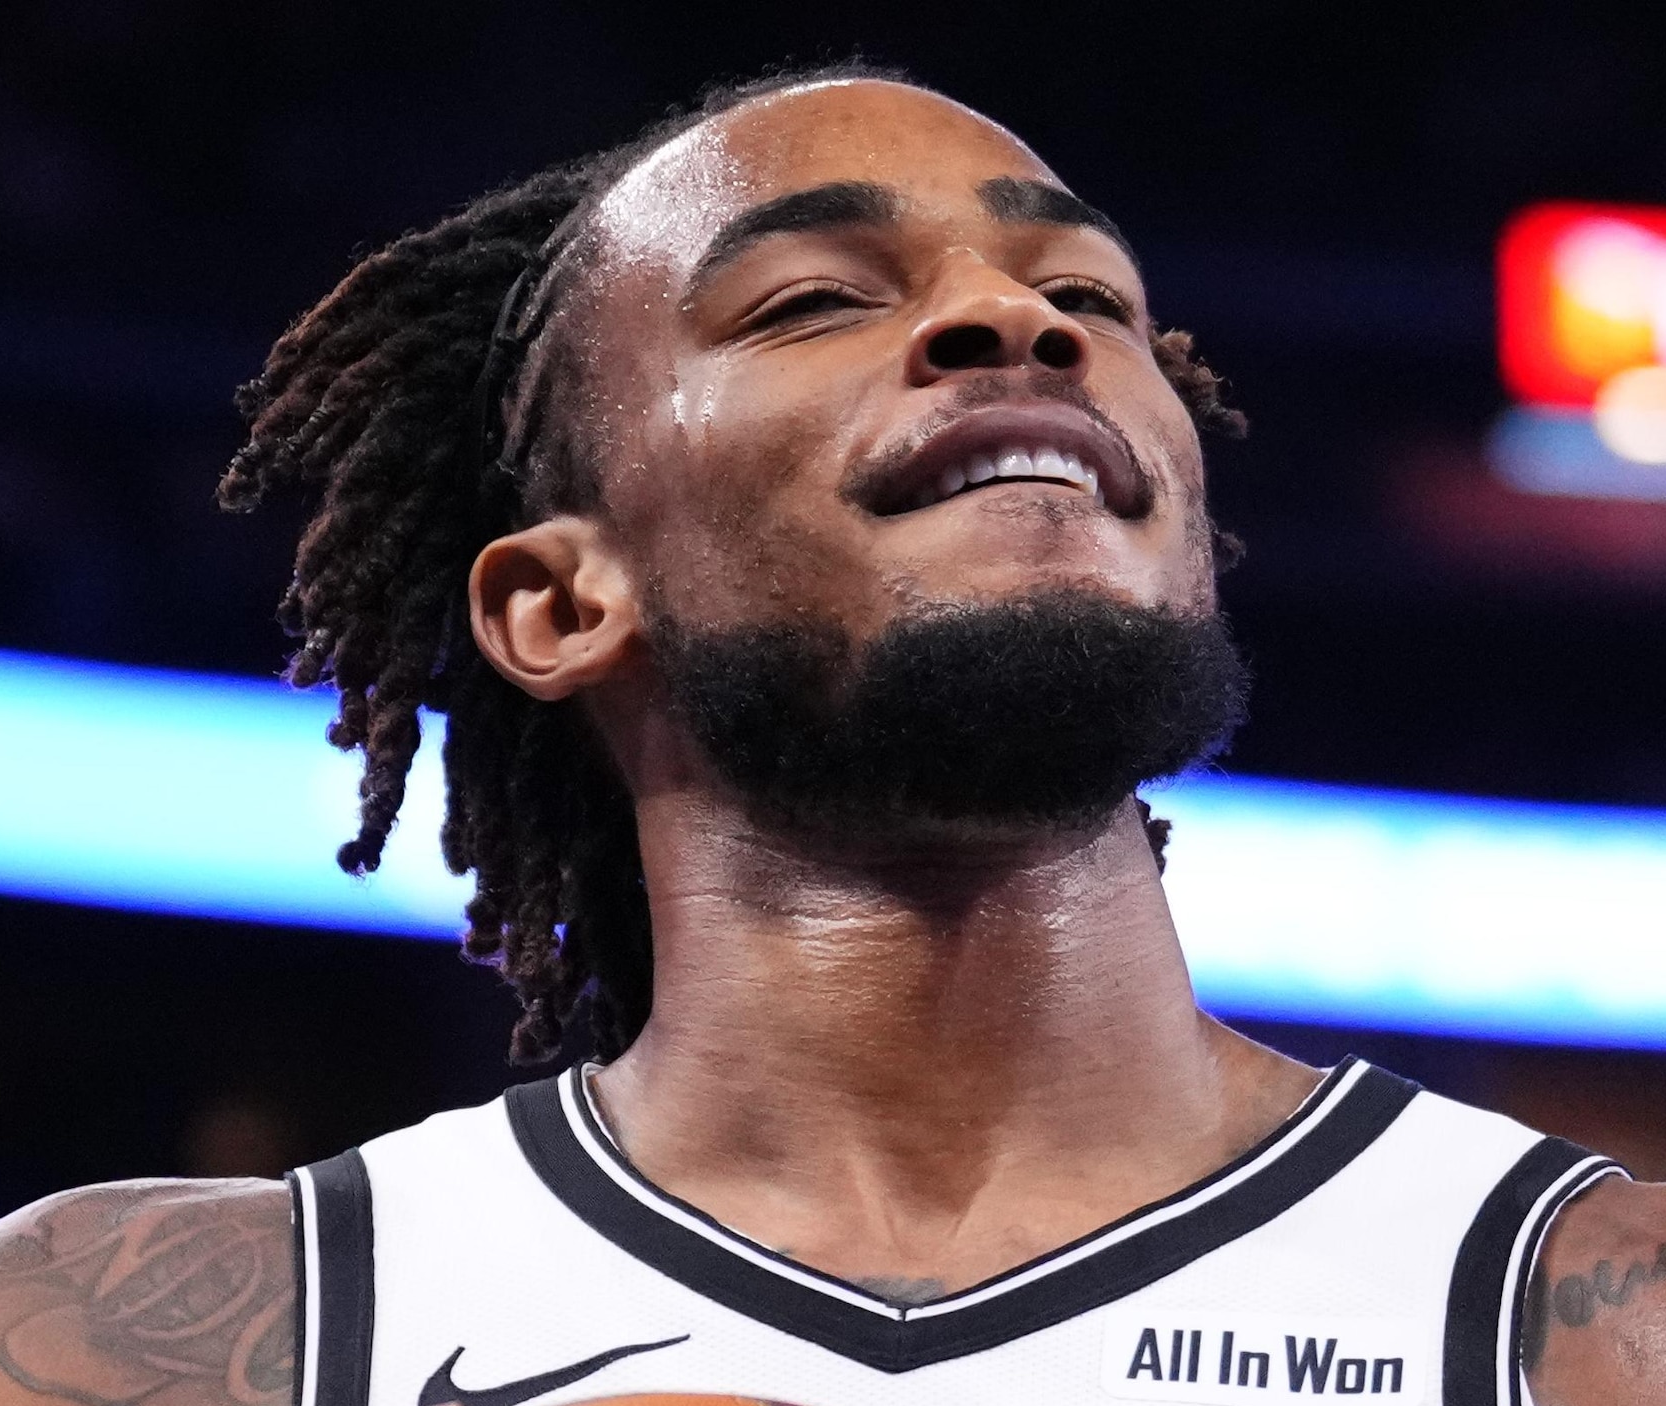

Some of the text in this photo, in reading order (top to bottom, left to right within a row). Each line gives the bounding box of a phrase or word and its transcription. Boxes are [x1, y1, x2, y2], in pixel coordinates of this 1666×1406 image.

[1126, 1327, 1404, 1395] All In Won
